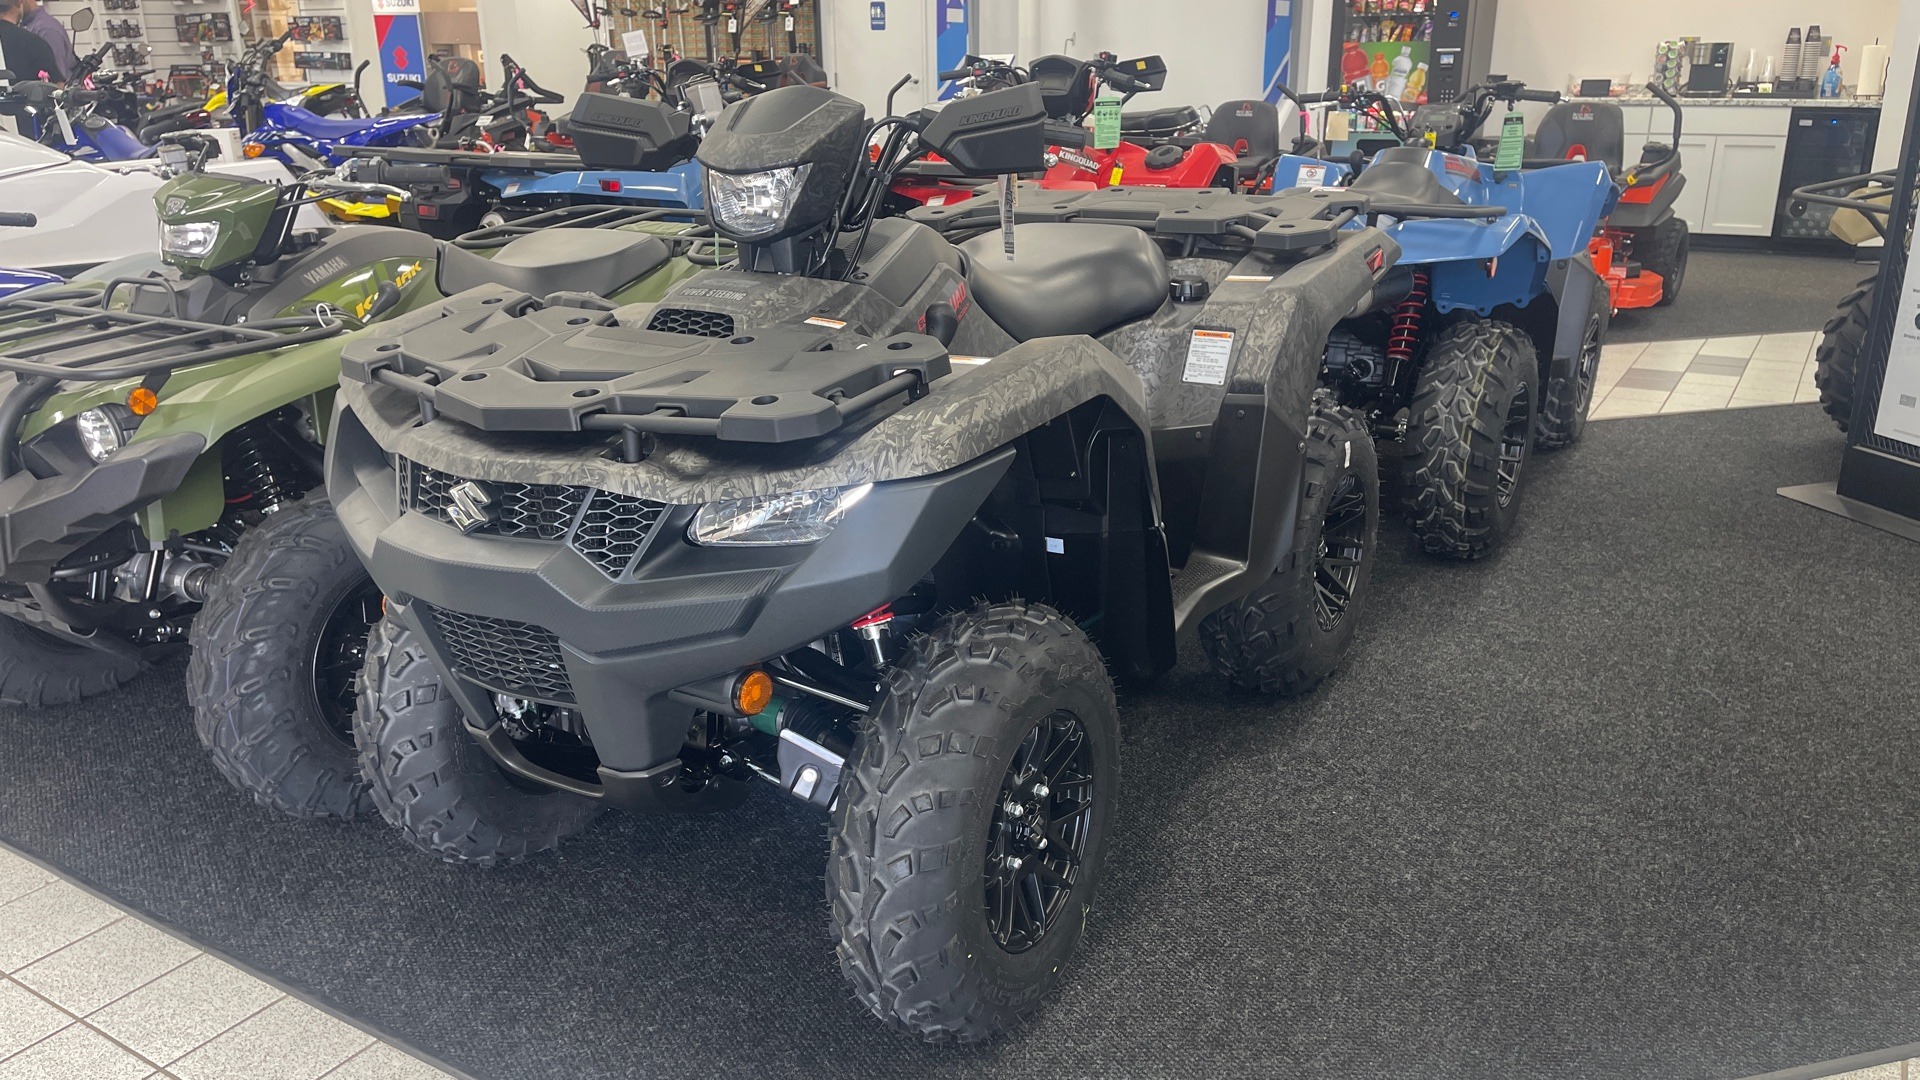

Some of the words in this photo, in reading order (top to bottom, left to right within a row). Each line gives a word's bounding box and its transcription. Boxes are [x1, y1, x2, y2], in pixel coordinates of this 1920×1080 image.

[387, 73, 421, 83] SUZUKI
[959, 105, 1022, 125] KINGQUAD
[1058, 150, 1100, 170] KINGQUAD
[304, 256, 347, 284] YAMAHA
[355, 260, 423, 318] KIAK
[679, 287, 709, 296] POWER
[706, 289, 747, 301] STEERING
